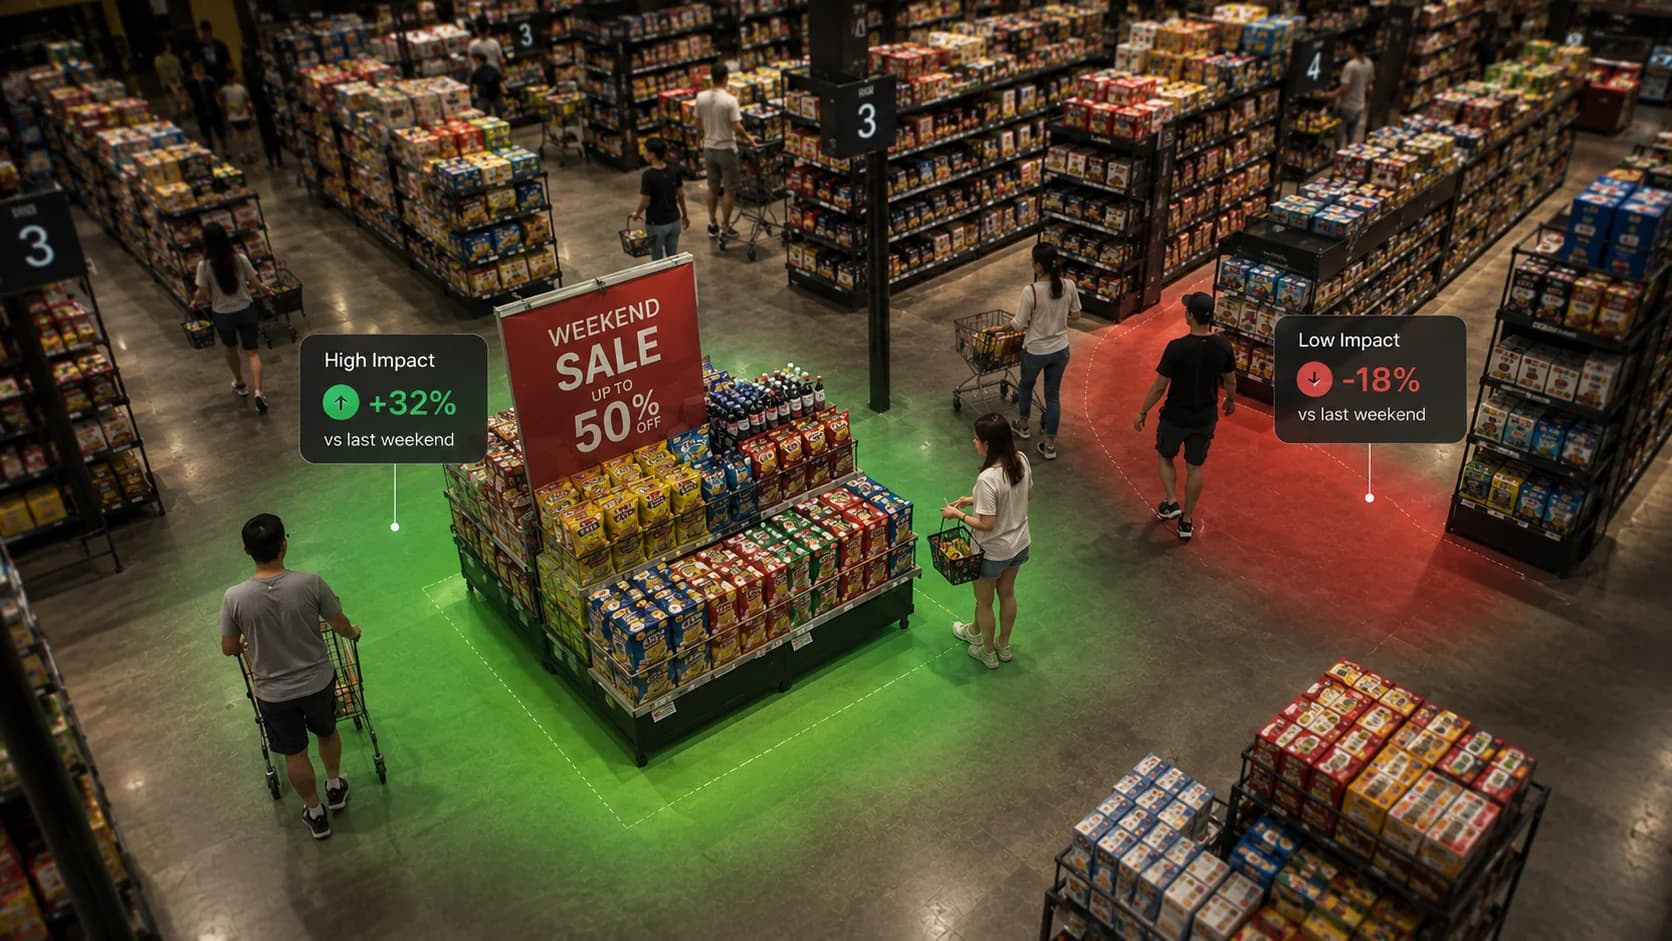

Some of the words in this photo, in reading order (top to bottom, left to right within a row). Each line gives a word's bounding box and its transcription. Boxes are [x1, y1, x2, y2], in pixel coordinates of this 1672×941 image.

[519, 23, 533, 47] 3
[1306, 52, 1321, 81] 4
[857, 103, 877, 139] 3
[18, 225, 55, 268] 3
[547, 297, 660, 347] WEEKEND
[556, 325, 662, 392] SALE
[591, 385, 611, 402] UP
[613, 378, 634, 396] TO
[574, 388, 661, 453] 50%
[636, 415, 662, 434] OFF
